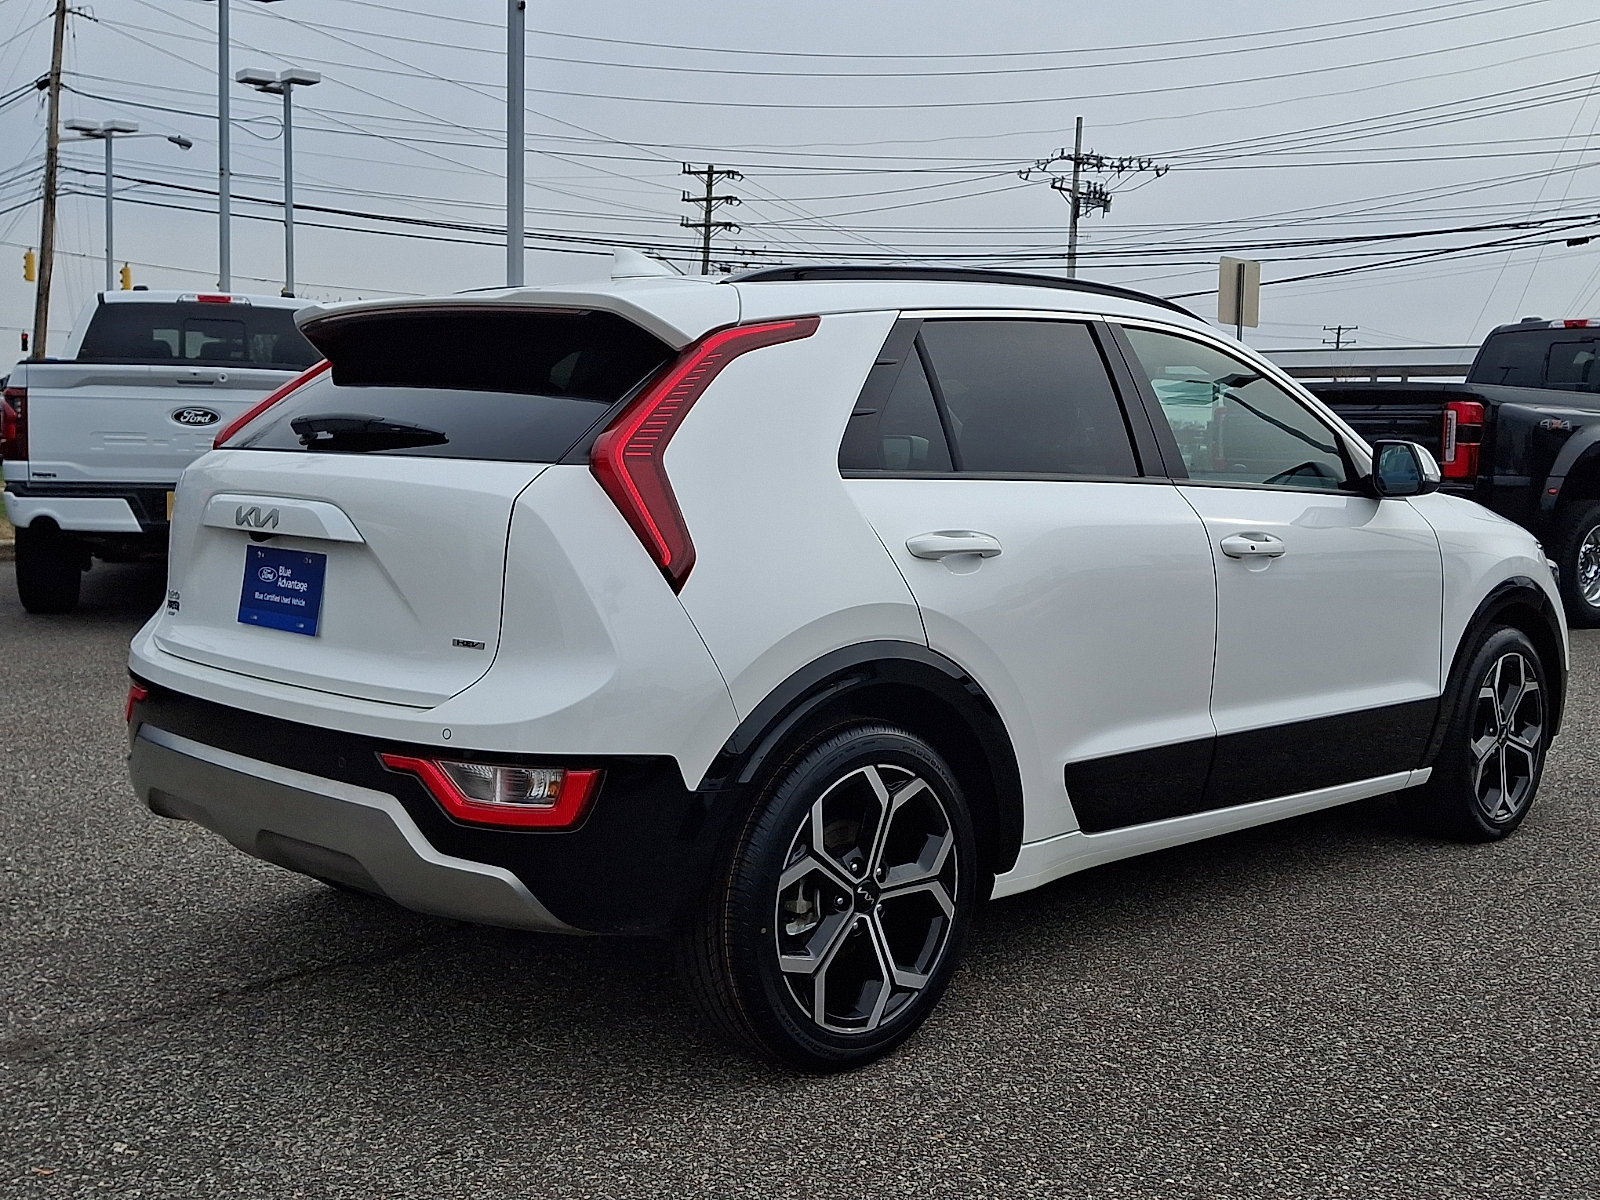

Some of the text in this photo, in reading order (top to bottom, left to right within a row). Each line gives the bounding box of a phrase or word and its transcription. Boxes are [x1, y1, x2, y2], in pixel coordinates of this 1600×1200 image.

[179, 409, 212, 423] Ford
[235, 505, 280, 529] KIA
[278, 566, 292, 577] Blue
[277, 577, 308, 592] Advantage
[254, 591, 306, 607] Blue Certified Used Vehicle
